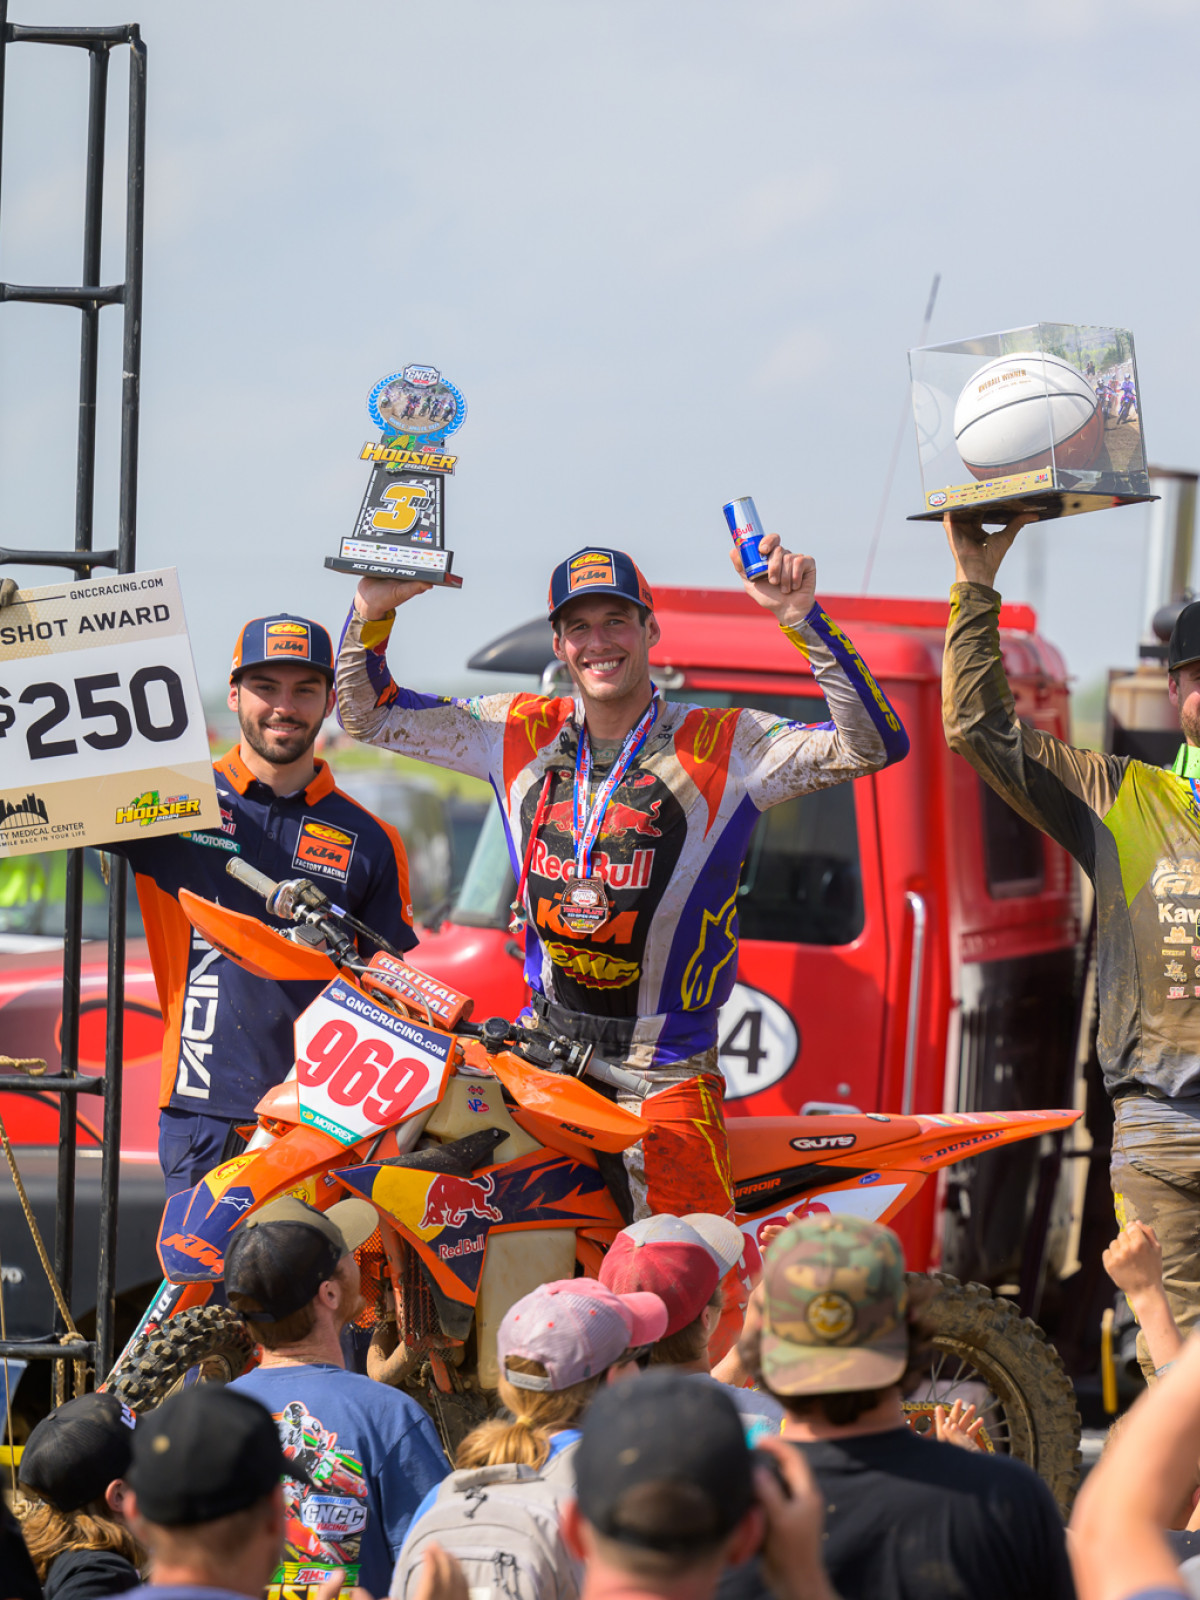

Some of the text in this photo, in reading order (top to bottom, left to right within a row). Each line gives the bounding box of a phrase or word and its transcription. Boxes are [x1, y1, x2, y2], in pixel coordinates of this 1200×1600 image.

[361, 442, 458, 470] HOOSIER
[369, 566, 395, 574] OPEN
[396, 569, 417, 577] PRO
[69, 577, 164, 601] GNCCRACING.COM
[78, 602, 171, 635] AWARD
[0, 664, 190, 761] $250
[115, 798, 201, 825] HOOSIER
[12, 826, 50, 839] MEDICAL
[51, 822, 85, 834] CENTER
[20, 837, 38, 845] BACK
[40, 835, 49, 843] IN
[51, 833, 70, 841] YOUR
[191, 833, 240, 852] MOTOREX
[305, 844, 344, 864] KTM
[295, 858, 346, 879] FACTORY RACING
[376, 955, 460, 1006] RENTHAL
[345, 995, 447, 1058] GNCCRACING.COM
[297, 1019, 431, 1127] 969
[313, 1115, 356, 1143] MOTOREX
[559, 1122, 595, 1140] KTM
[793, 1135, 855, 1151] GUTS
[439, 1234, 485, 1260] Red Bull
[305, 1504, 365, 1526] GNCC
[316, 1523, 350, 1532] RACING
